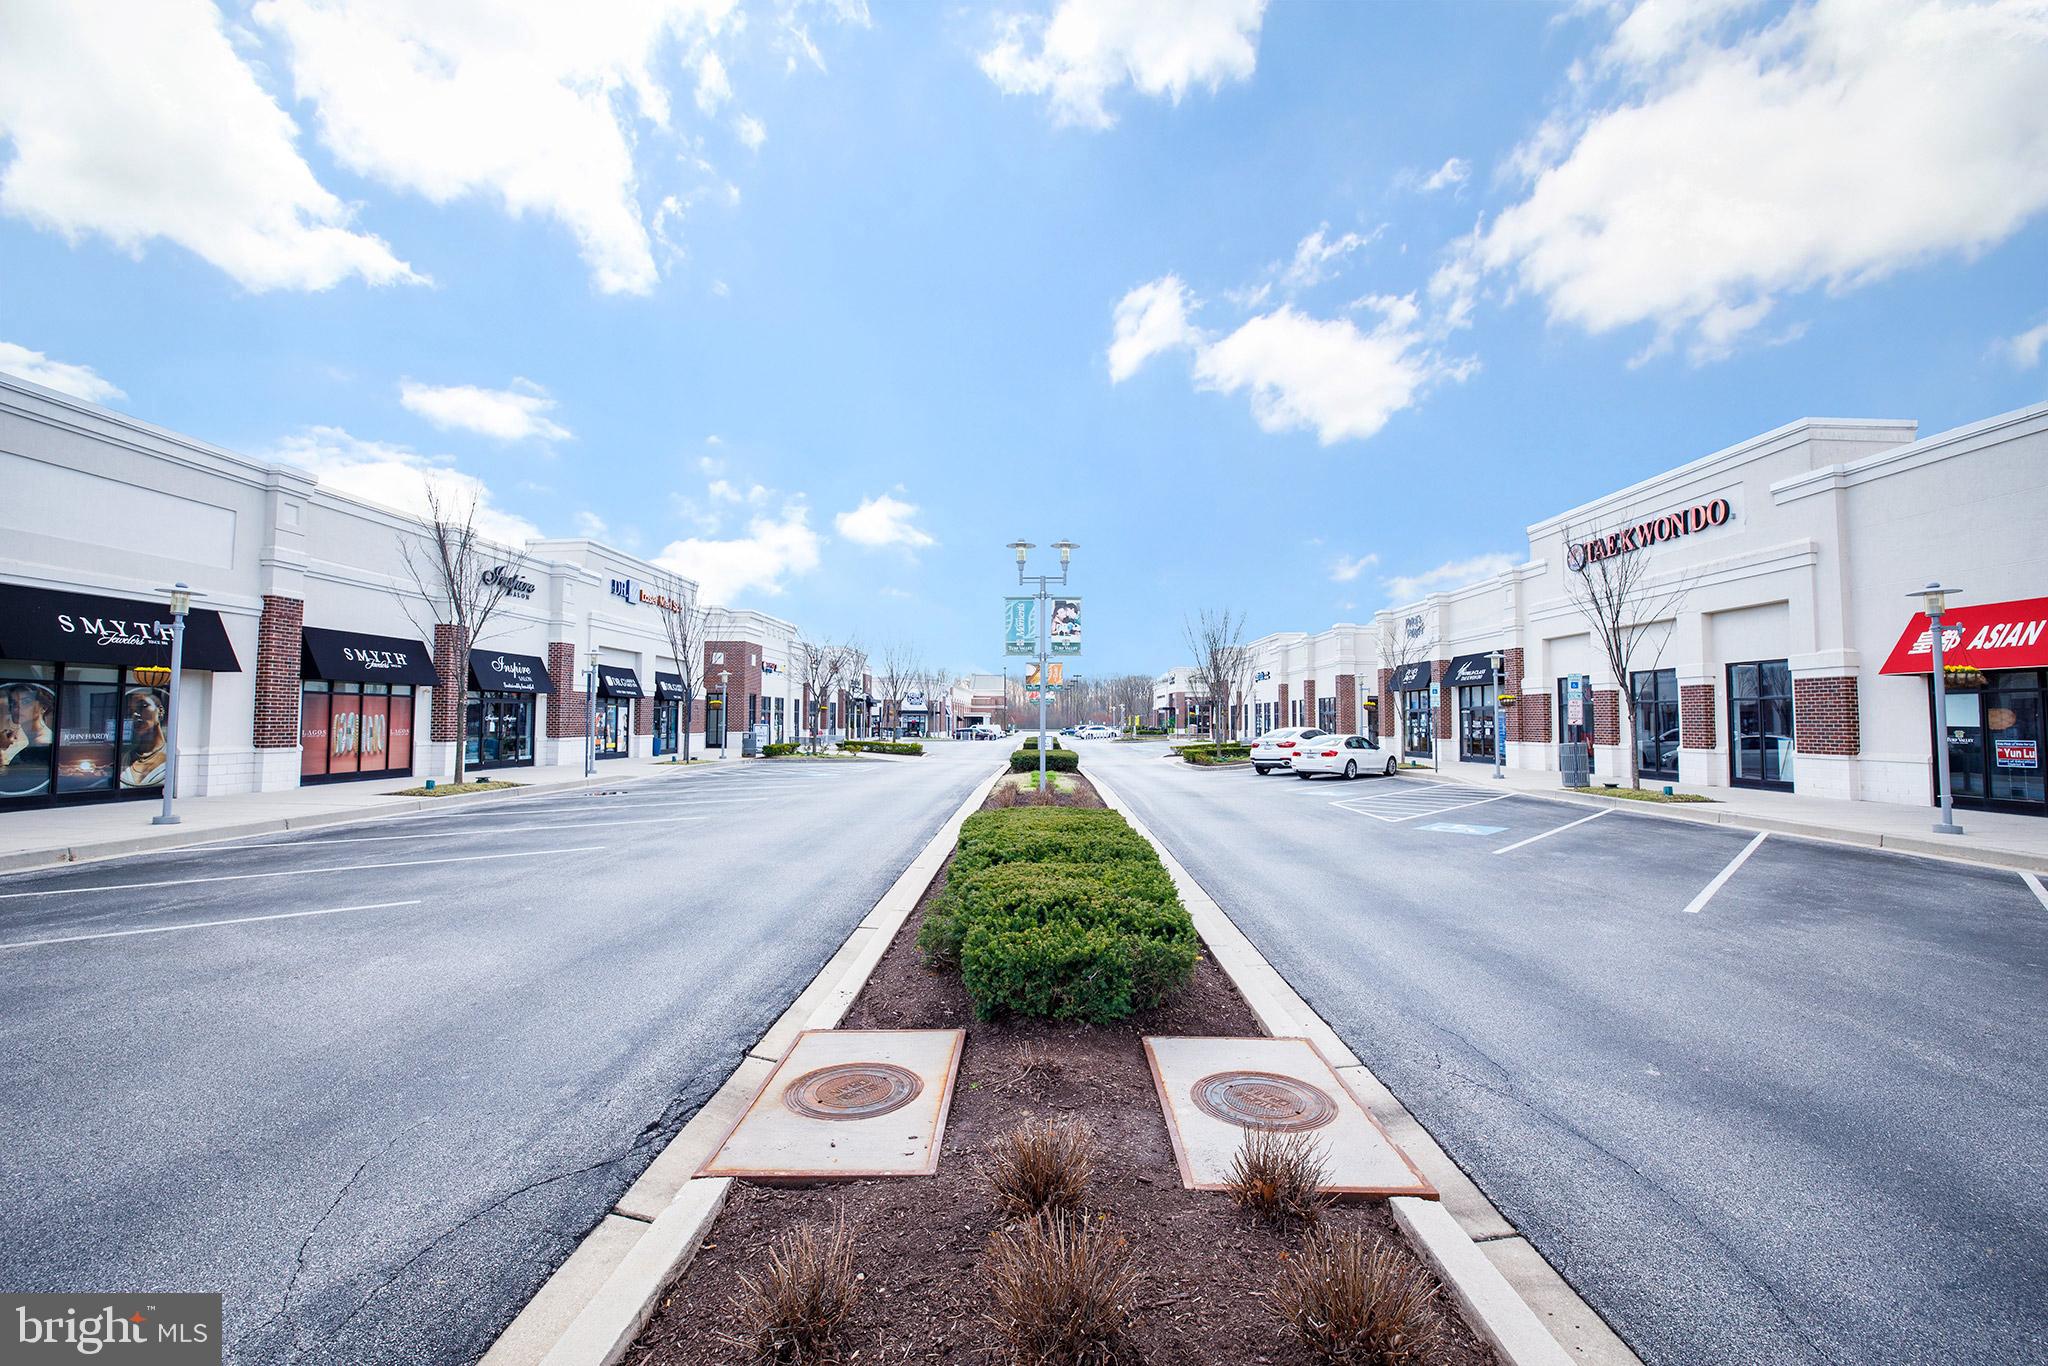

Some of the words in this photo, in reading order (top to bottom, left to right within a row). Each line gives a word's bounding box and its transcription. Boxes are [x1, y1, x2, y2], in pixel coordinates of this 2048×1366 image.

[58, 614, 174, 641] SMYTH
[1966, 619, 2047, 651] ASIAN
[97, 630, 145, 646] Jewelers
[343, 647, 408, 666] SMYTH
[491, 655, 532, 679] Inspire
[64, 733, 84, 741] JOHN
[85, 733, 110, 741] HARDY
[2004, 748, 2022, 758] Yun
[2023, 748, 2036, 758] Lu
